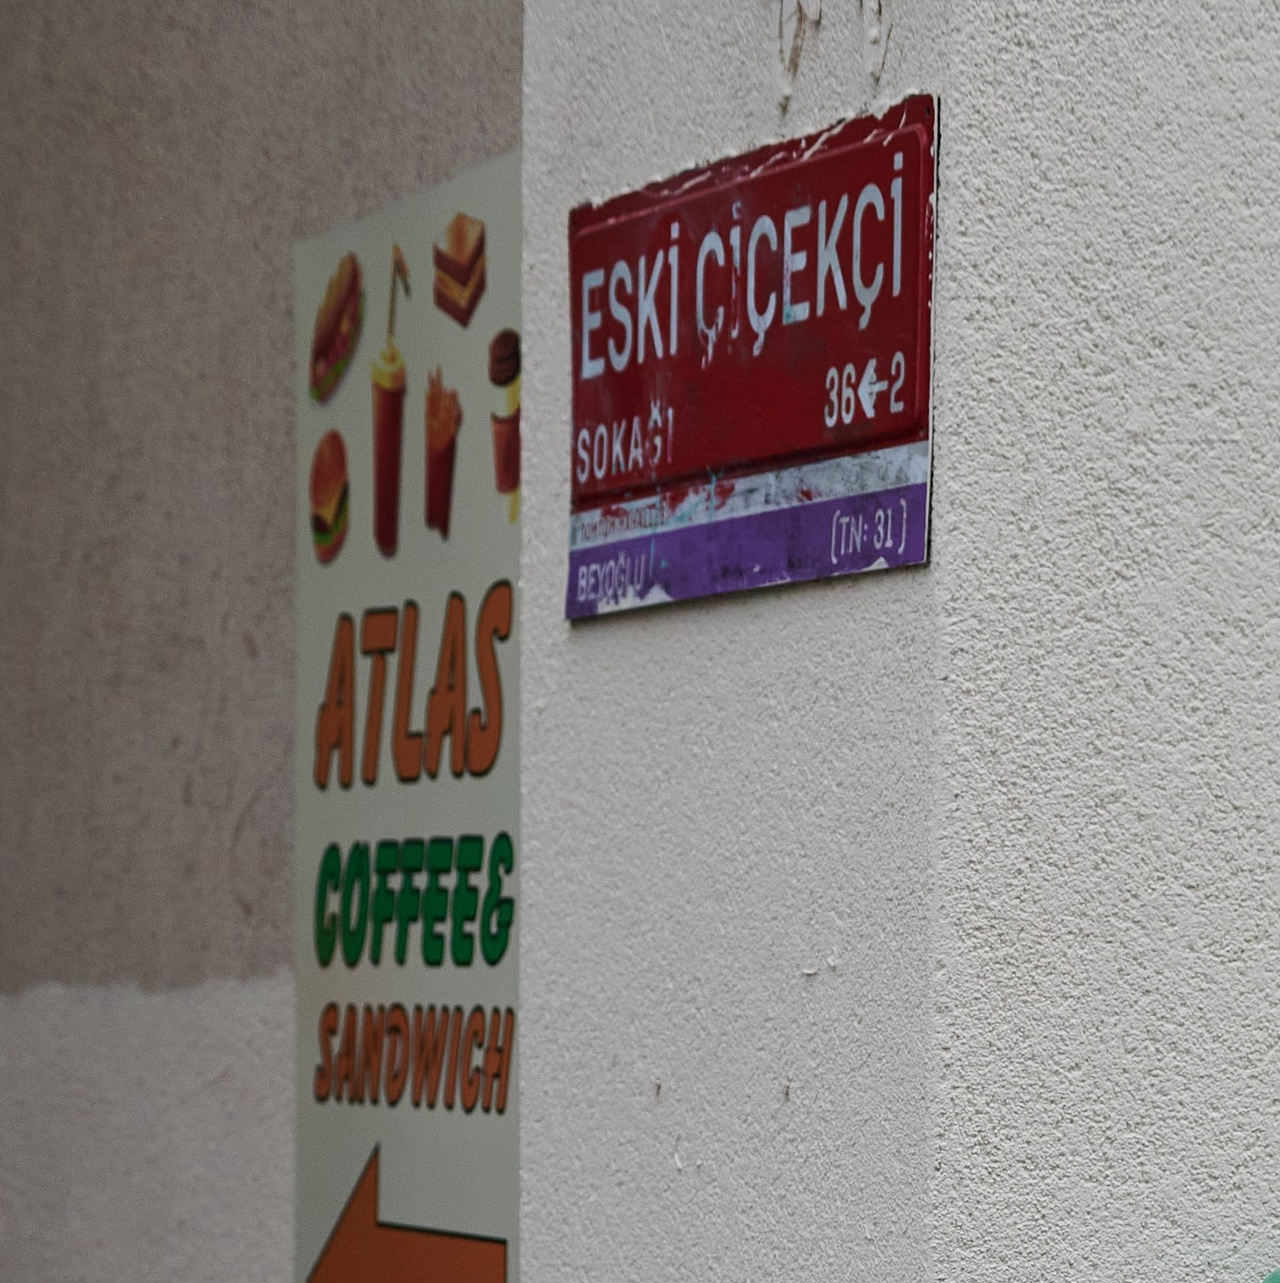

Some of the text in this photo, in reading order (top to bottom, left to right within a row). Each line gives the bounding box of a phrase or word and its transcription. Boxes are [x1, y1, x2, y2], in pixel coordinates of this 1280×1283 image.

[581, 151, 904, 381] ESKİ ÇİÇEKÇİ
[576, 396, 674, 484] SOKAĞI
[313, 578, 514, 790] ATLAS
[313, 1001, 515, 1116] SANDWICH
